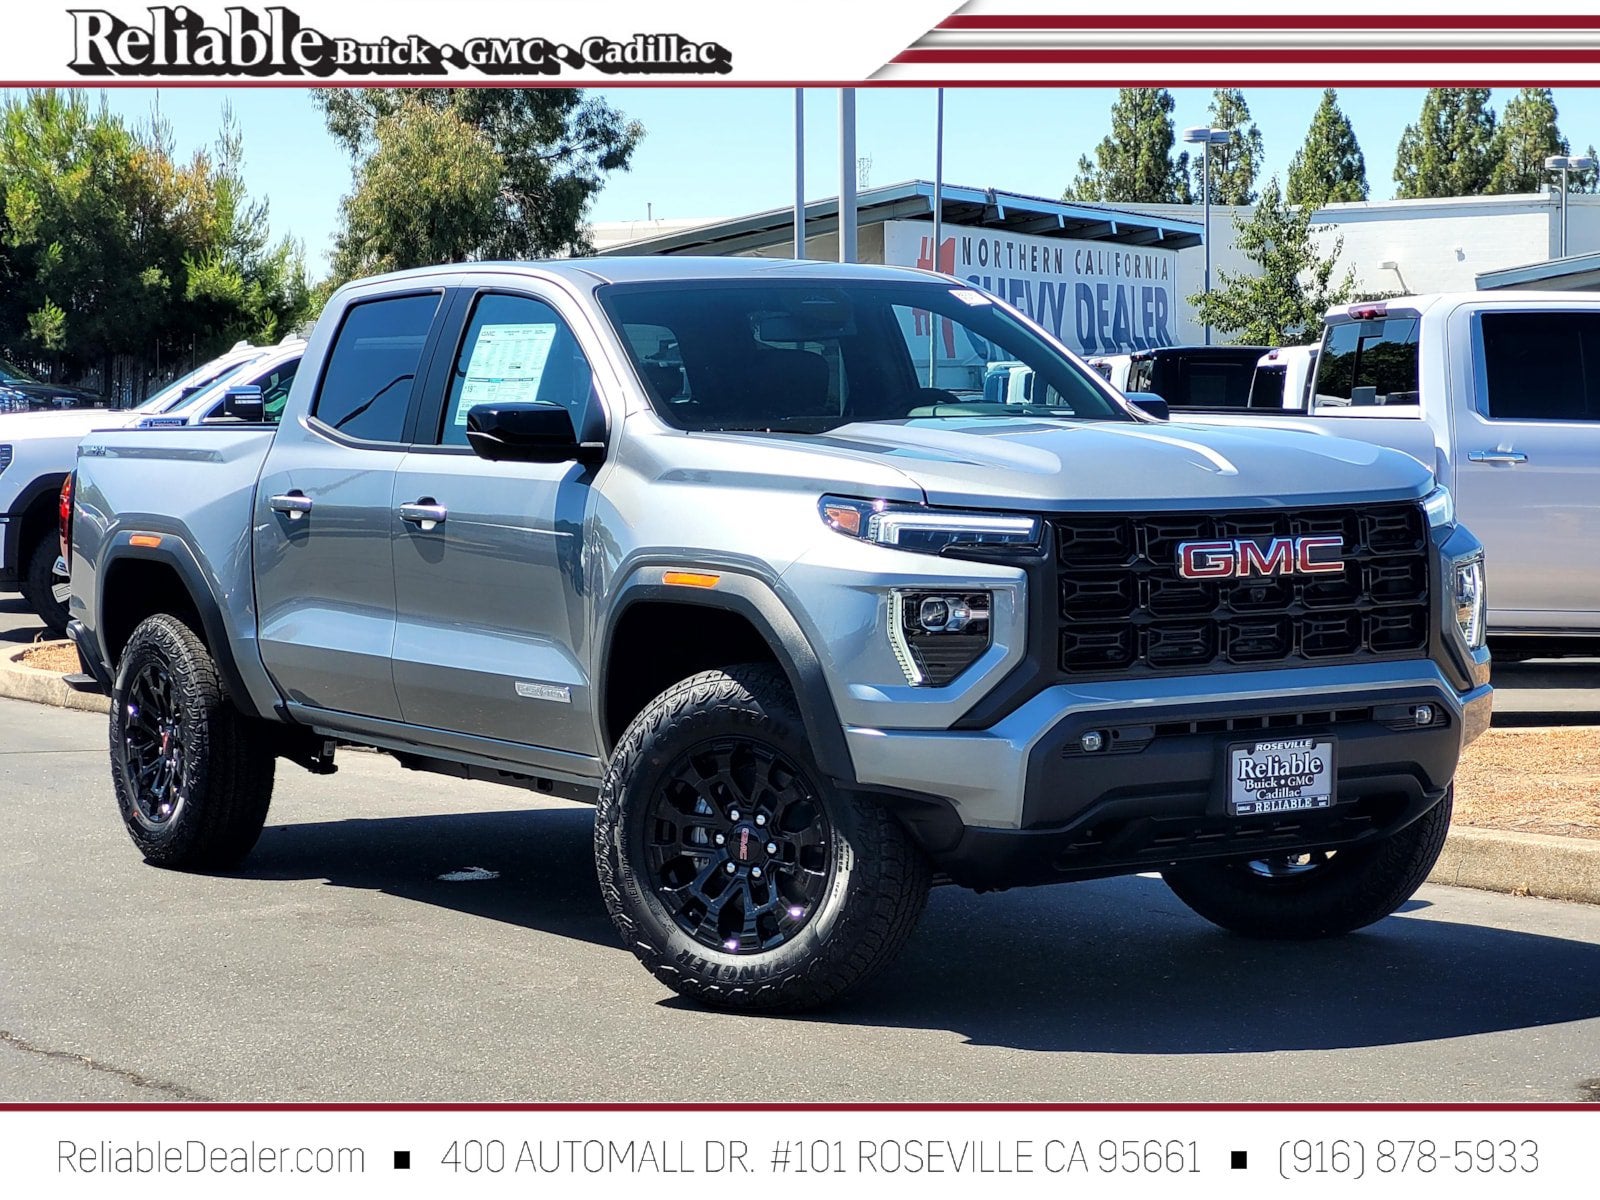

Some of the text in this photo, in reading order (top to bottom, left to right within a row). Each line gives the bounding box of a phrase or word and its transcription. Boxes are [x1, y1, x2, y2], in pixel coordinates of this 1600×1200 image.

[961, 236, 1168, 281] NORTHERN CALIFORNIA
[1074, 282, 1173, 356] DEALER
[1178, 536, 1345, 579] GMC
[1256, 740, 1312, 751] ROSEVILLE
[1239, 752, 1323, 780] Reliable
[1246, 774, 1314, 790] Buick GMC
[1255, 797, 1312, 813] RELIABLE
[1256, 787, 1301, 801] Cadillac
